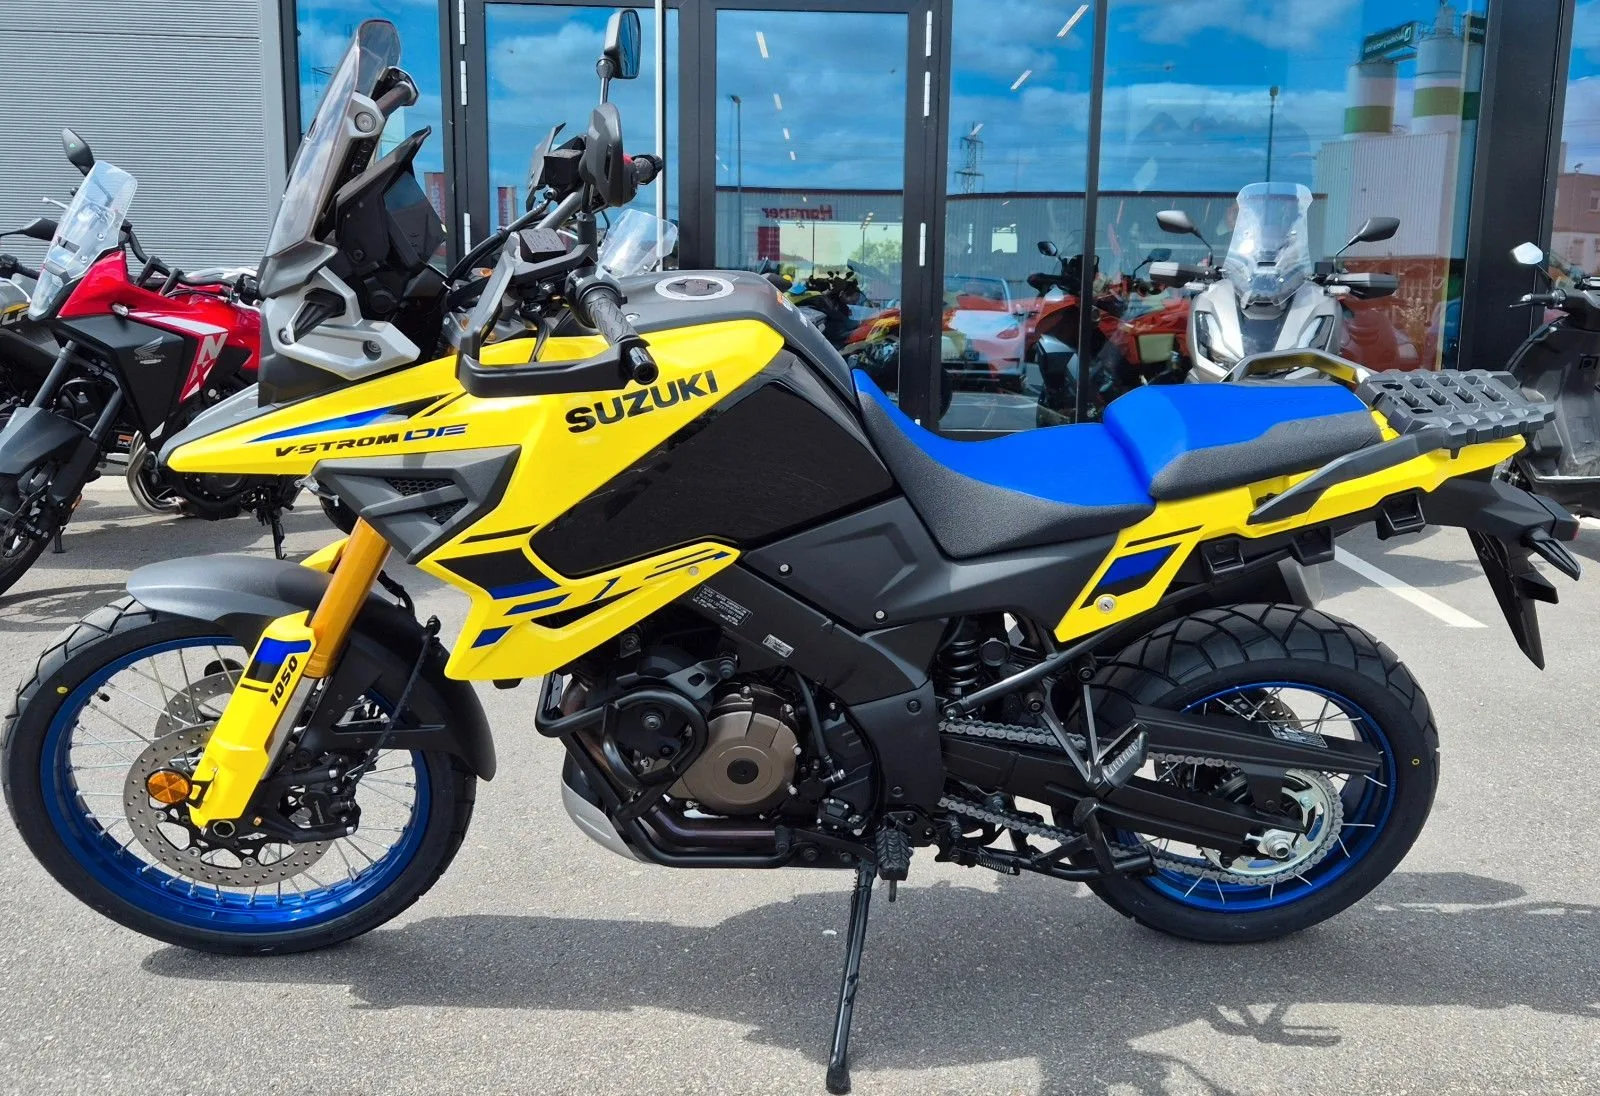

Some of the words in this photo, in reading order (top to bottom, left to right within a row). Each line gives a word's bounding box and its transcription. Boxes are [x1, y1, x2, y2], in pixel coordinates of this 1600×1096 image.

[565, 369, 719, 434] SUZUKI
[402, 423, 469, 441] DE
[270, 655, 298, 707] 1050
